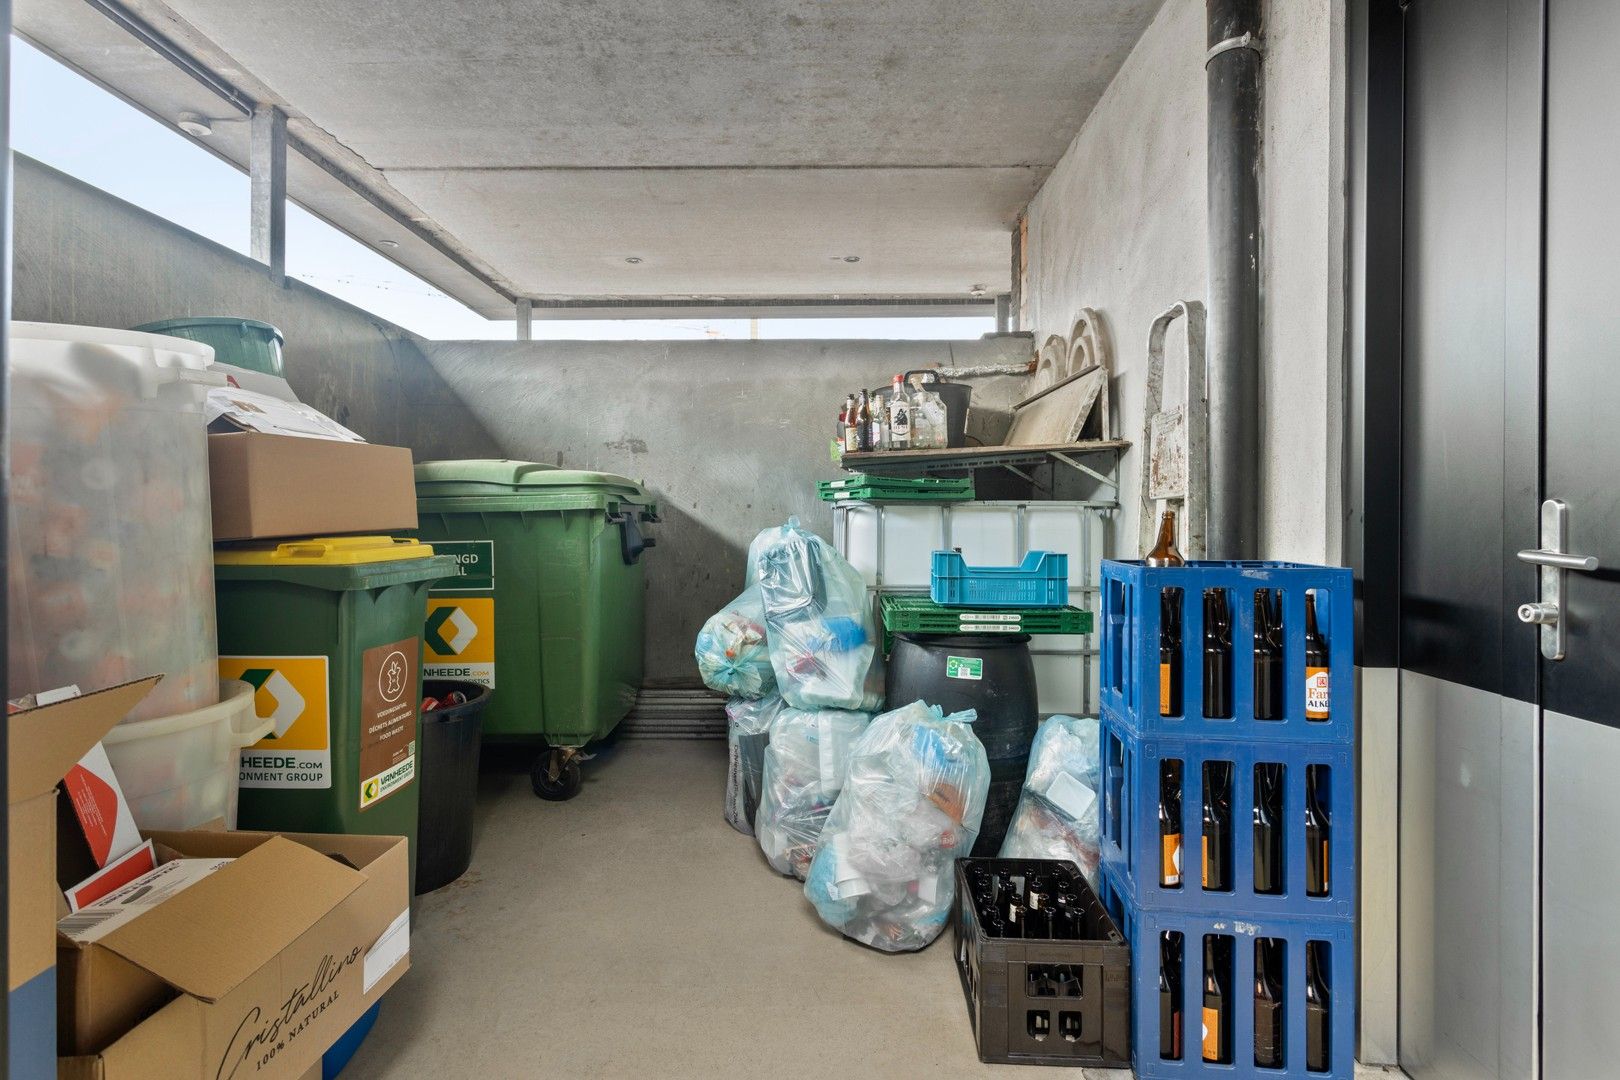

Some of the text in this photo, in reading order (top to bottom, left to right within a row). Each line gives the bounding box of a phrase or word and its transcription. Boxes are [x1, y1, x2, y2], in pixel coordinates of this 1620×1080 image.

[380, 731, 392, 740] FOOD
[241, 757, 323, 769] HEEDE.COM
[286, 773, 323, 782] GROUP
[381, 760, 413, 785] VANHEEDE
[216, 946, 363, 1080] Cristallino
[256, 990, 340, 1072] 100% NATURAL
